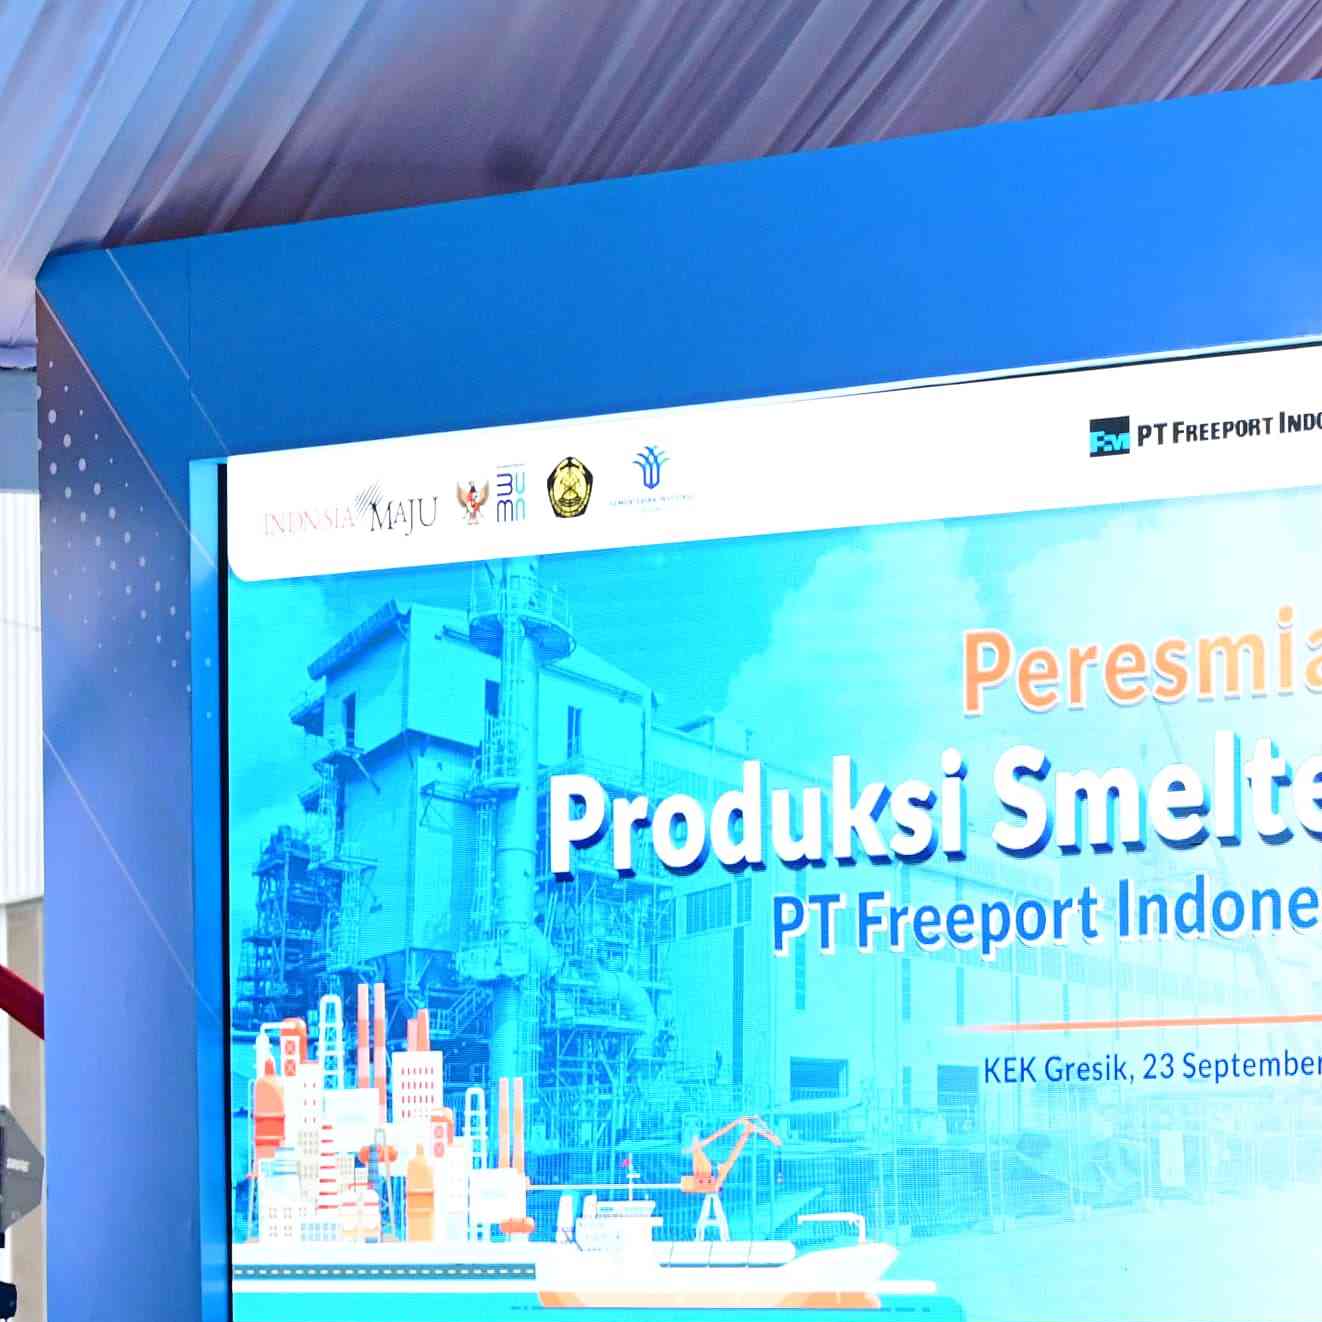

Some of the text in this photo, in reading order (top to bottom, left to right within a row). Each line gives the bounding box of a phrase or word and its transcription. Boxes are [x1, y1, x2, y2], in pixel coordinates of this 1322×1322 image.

[1137, 423, 1168, 447] PT
[1172, 416, 1273, 443] FREEPORT
[369, 495, 438, 537] MAJU
[549, 747, 967, 881] Produksi
[773, 891, 838, 952] PT
[858, 886, 1096, 959] Freeport
[984, 1056, 1037, 1083] KEK
[1045, 1053, 1135, 1084] Gresik,
[1143, 1053, 1175, 1080] 23
